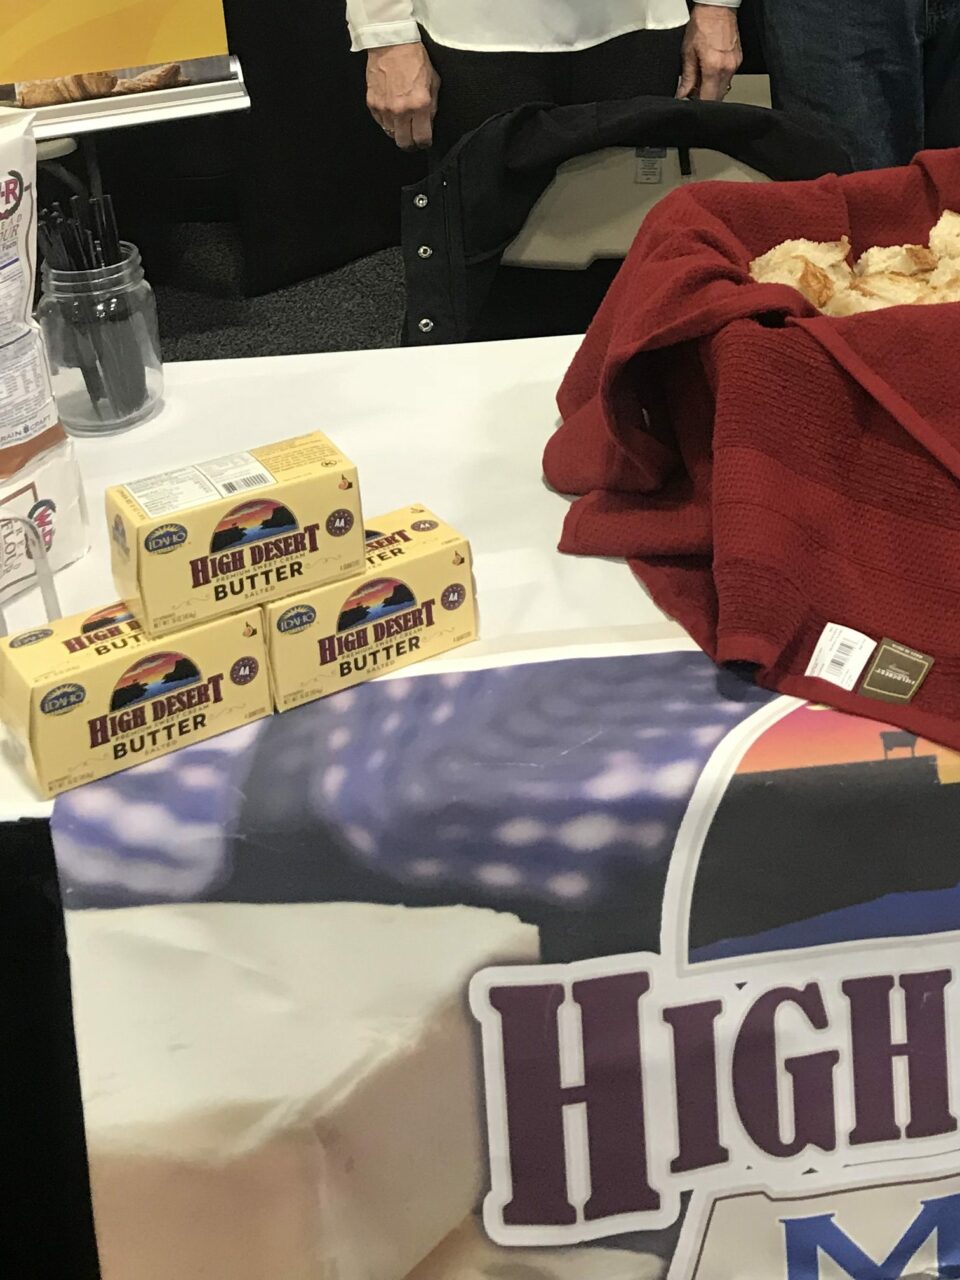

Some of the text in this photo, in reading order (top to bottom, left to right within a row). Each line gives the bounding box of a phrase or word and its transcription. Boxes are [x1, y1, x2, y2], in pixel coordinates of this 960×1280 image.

[334, 517, 345, 528] AA
[148, 532, 187, 551] IDAHO
[189, 523, 320, 589] HIGH DESERT
[215, 552, 306, 583] PREMIUM SWEET CREAM
[214, 560, 304, 602] BUTTER
[244, 585, 276, 600] SALTED
[448, 592, 458, 601] AA
[280, 611, 315, 631] IDAHO
[318, 598, 435, 666] HIGH DESERT
[62, 625, 125, 653] HIGH
[342, 645, 374, 659] PREMIUM
[399, 627, 423, 639] CREAM
[339, 635, 421, 677] BUTTER
[366, 659, 396, 674] SALTED
[239, 666, 250, 676] AA
[43, 688, 86, 713] IDAHO
[88, 673, 224, 749] HIGH DESERT
[178, 705, 209, 717] CREAM
[113, 713, 207, 760] BUTTER
[145, 740, 178, 755] SALTED
[488, 967, 959, 1227] HIGH
